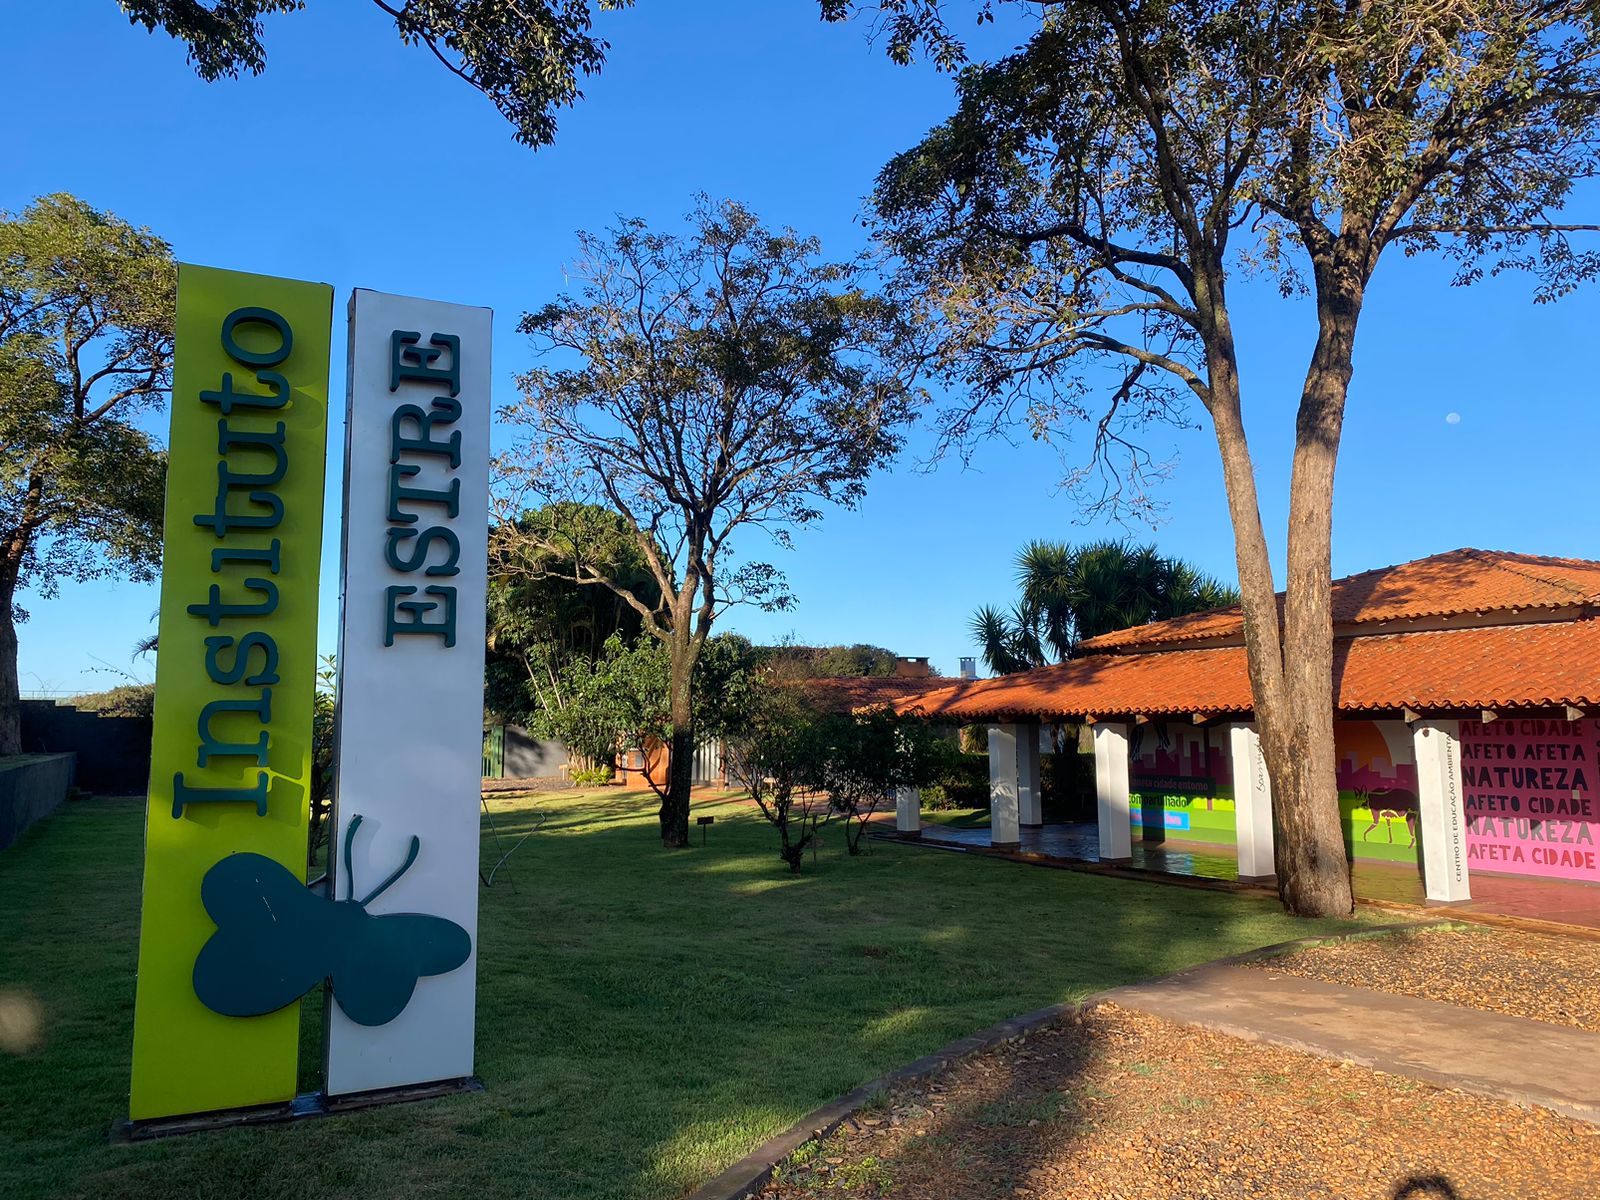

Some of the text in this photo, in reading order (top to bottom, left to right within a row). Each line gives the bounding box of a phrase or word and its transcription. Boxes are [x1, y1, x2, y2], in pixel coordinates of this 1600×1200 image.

[383, 329, 462, 648] ESTRE
[172, 307, 294, 819] Instituto
[1461, 720, 1583, 737] AFETO CIDADE
[1462, 743, 1586, 761] AFETO AFETA
[1462, 766, 1589, 791] NATUREZA
[1449, 783, 1458, 831] EDUCAÇÃO
[1466, 794, 1592, 816] AFETO CIDADE
[1453, 832, 1459, 845] DE
[1467, 814, 1594, 845] NATUREZA
[1468, 843, 1597, 869] AFETA CIDADE
